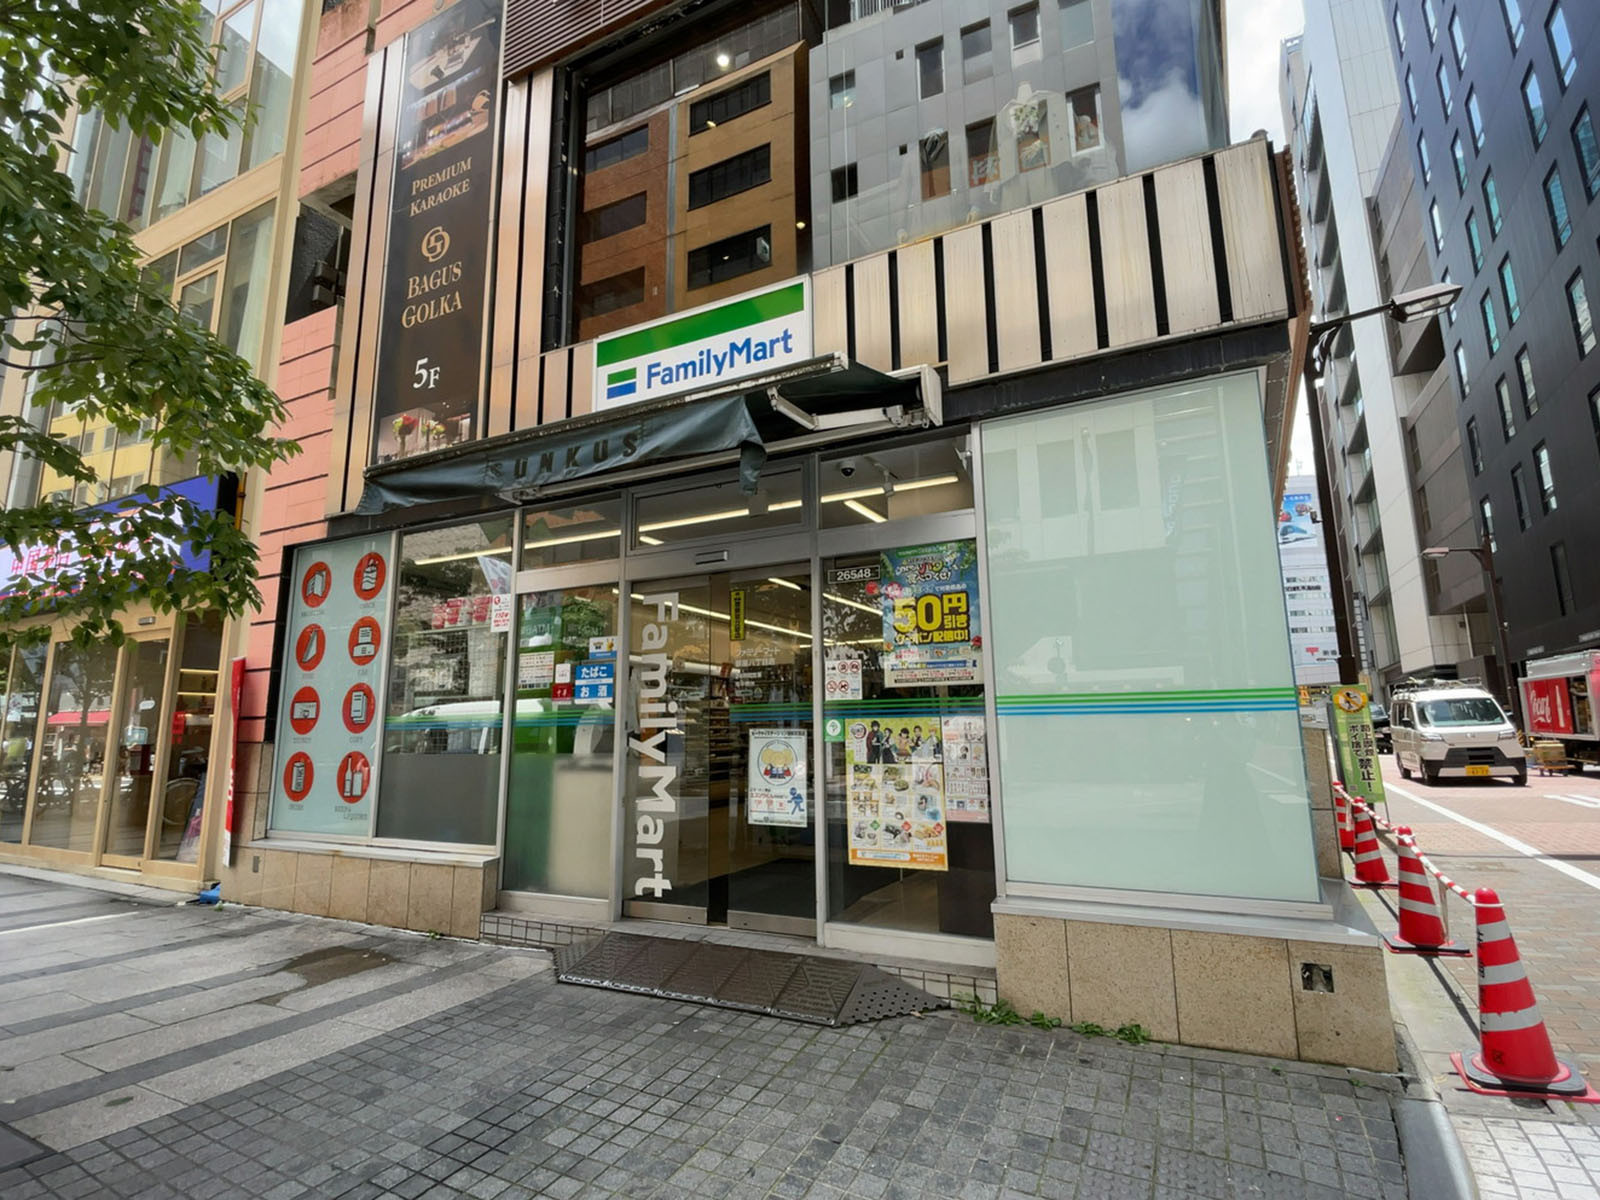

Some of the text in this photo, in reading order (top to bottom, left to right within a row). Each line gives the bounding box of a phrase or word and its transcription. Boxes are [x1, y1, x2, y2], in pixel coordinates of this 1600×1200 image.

[411, 157, 472, 195] PREMIUM
[409, 179, 471, 217] KARAOKE
[407, 261, 462, 300] BAGUS
[401, 290, 463, 329] GOLKA
[413, 357, 440, 389] 5F
[647, 328, 793, 390] FamilyMart
[836, 568, 872, 581] 26548
[581, 665, 608, 679] たばこ
[628, 592, 680, 898] FamilyMart
